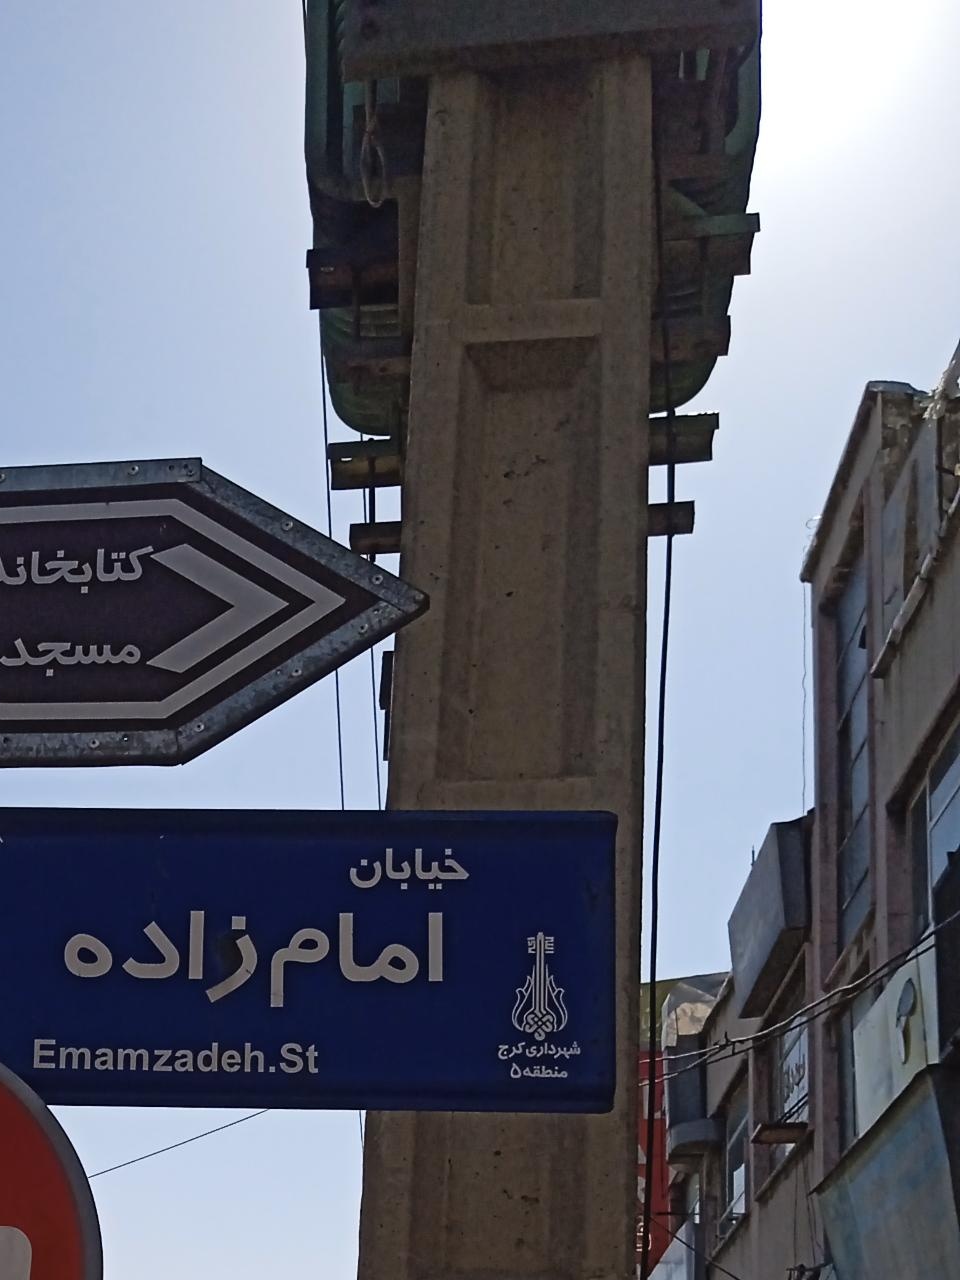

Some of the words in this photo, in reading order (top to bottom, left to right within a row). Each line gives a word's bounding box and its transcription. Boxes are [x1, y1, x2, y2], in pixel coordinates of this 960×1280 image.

[0, 637, 141, 677] مسجد
[350, 848, 469, 890] خیابان
[498, 1042, 526, 1060] کرج
[526, 1041, 581, 1059] شهرداری
